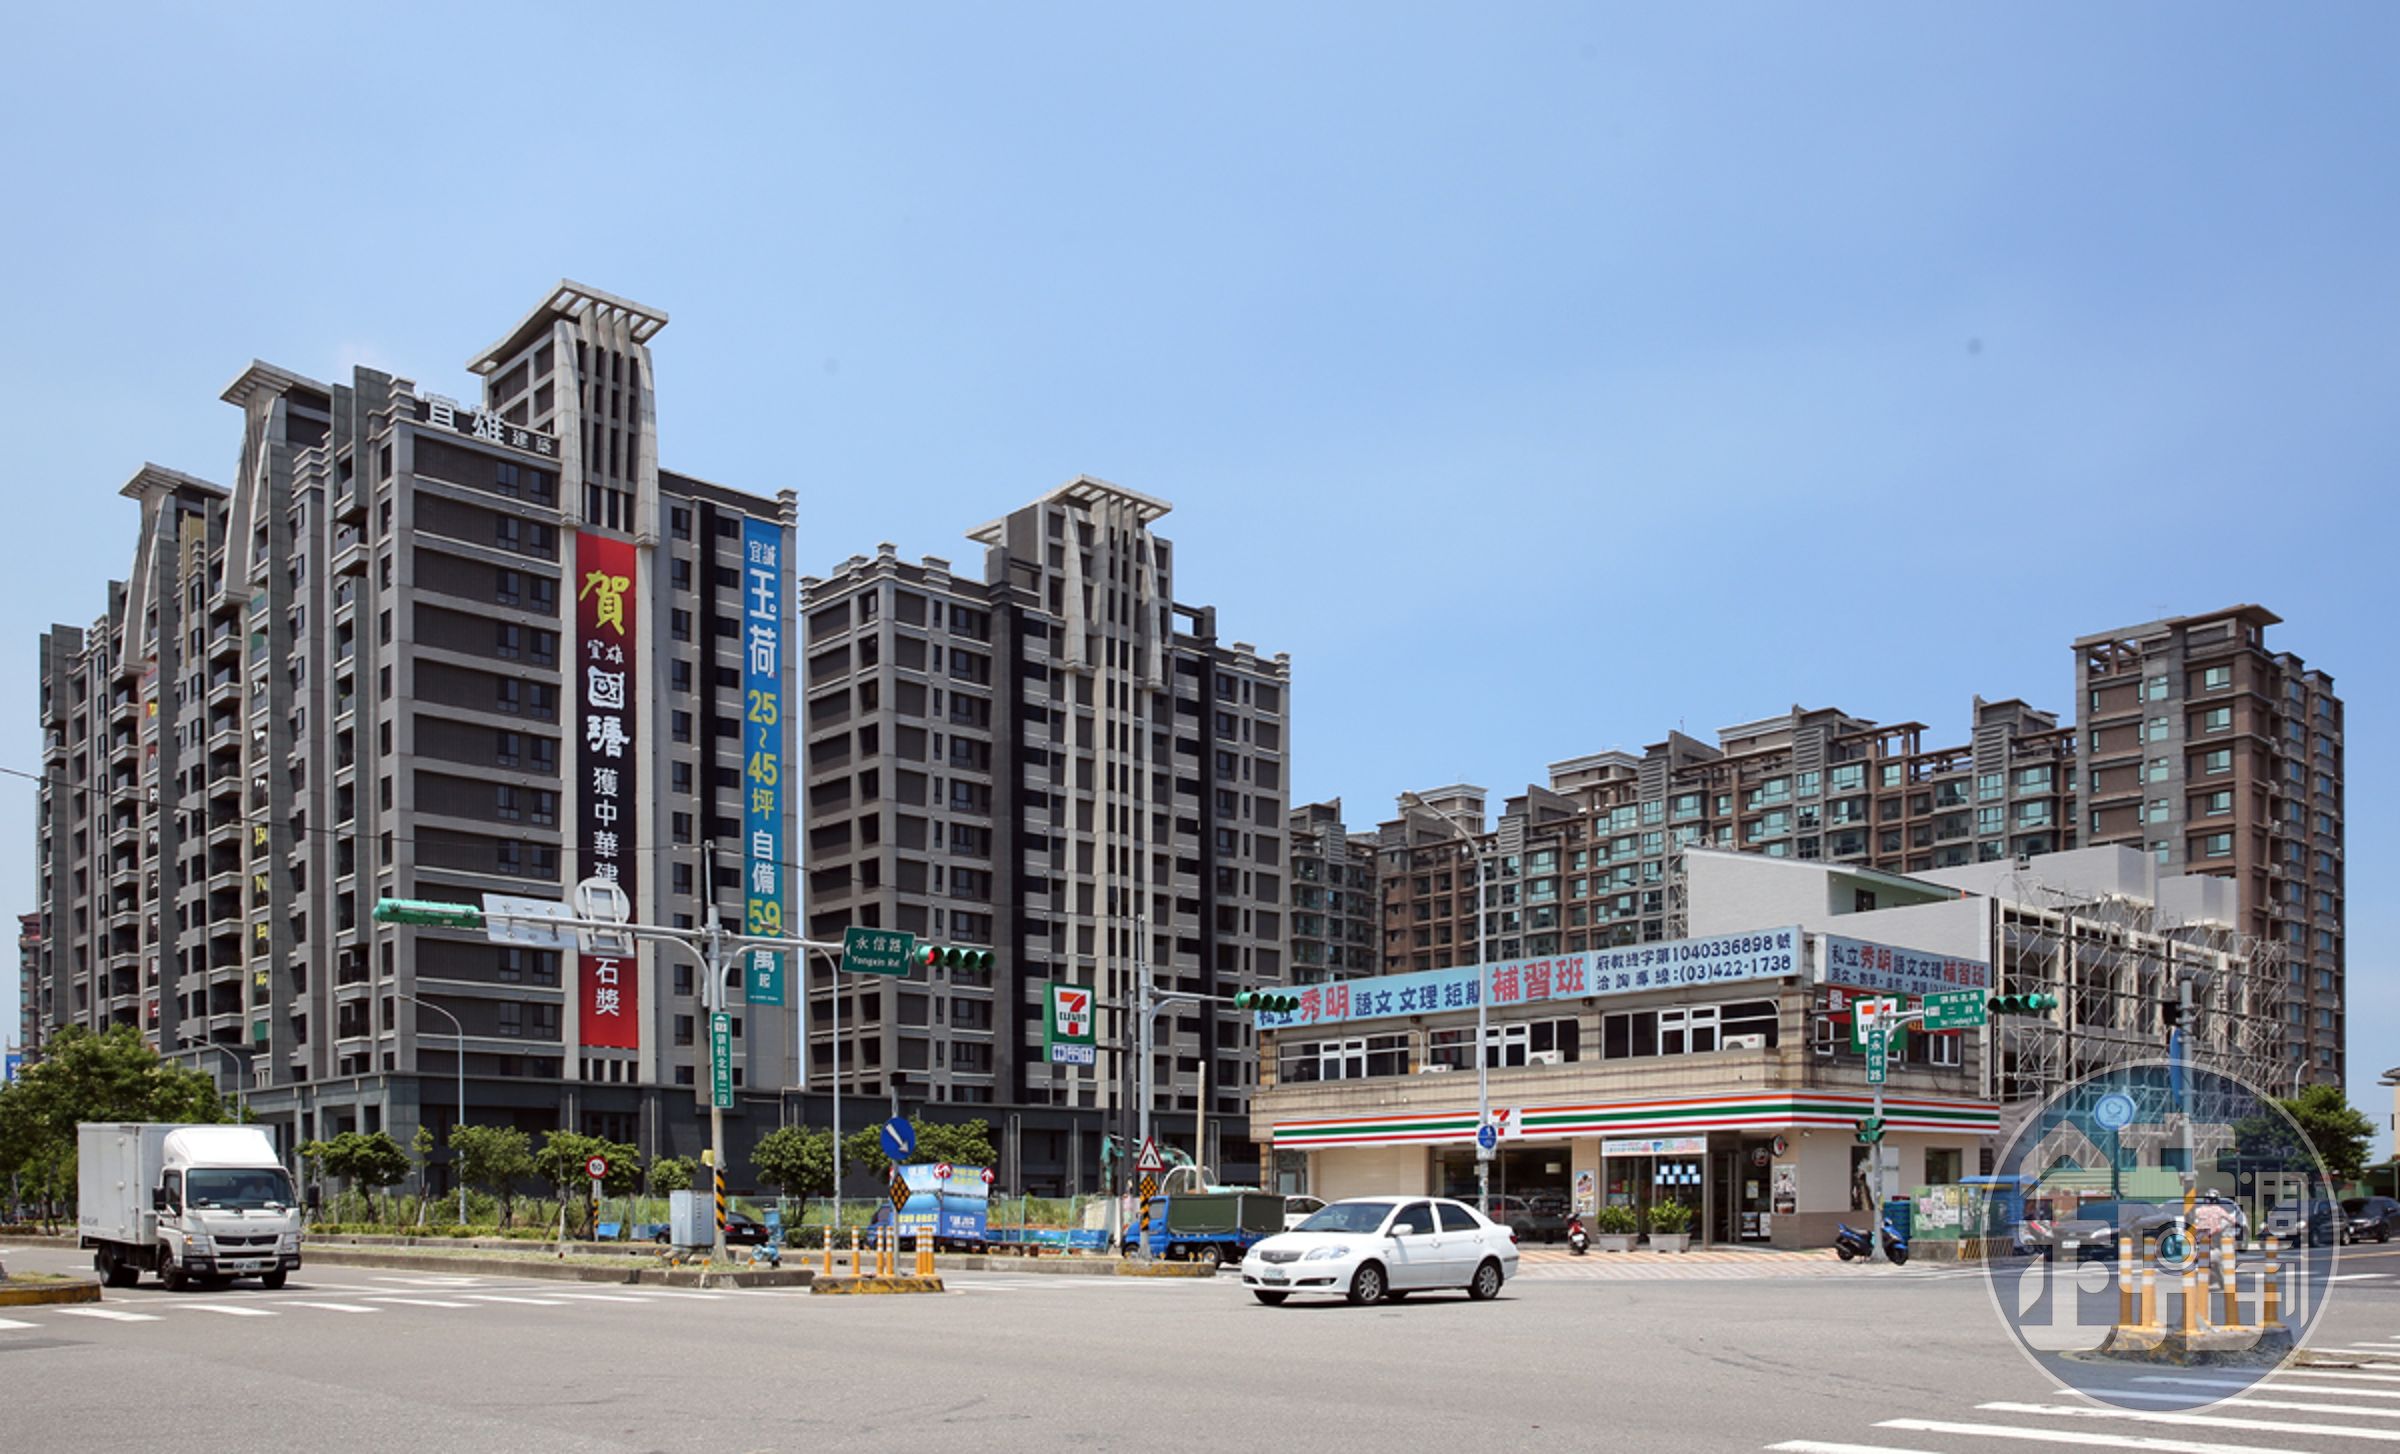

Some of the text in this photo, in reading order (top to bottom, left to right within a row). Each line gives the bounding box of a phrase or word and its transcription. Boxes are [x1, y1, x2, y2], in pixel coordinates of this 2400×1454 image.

[579, 569, 631, 636] 賀
[855, 935, 902, 953] 永信路
[1059, 991, 1087, 1035] 7
[1870, 1040, 1883, 1081] 永信路
